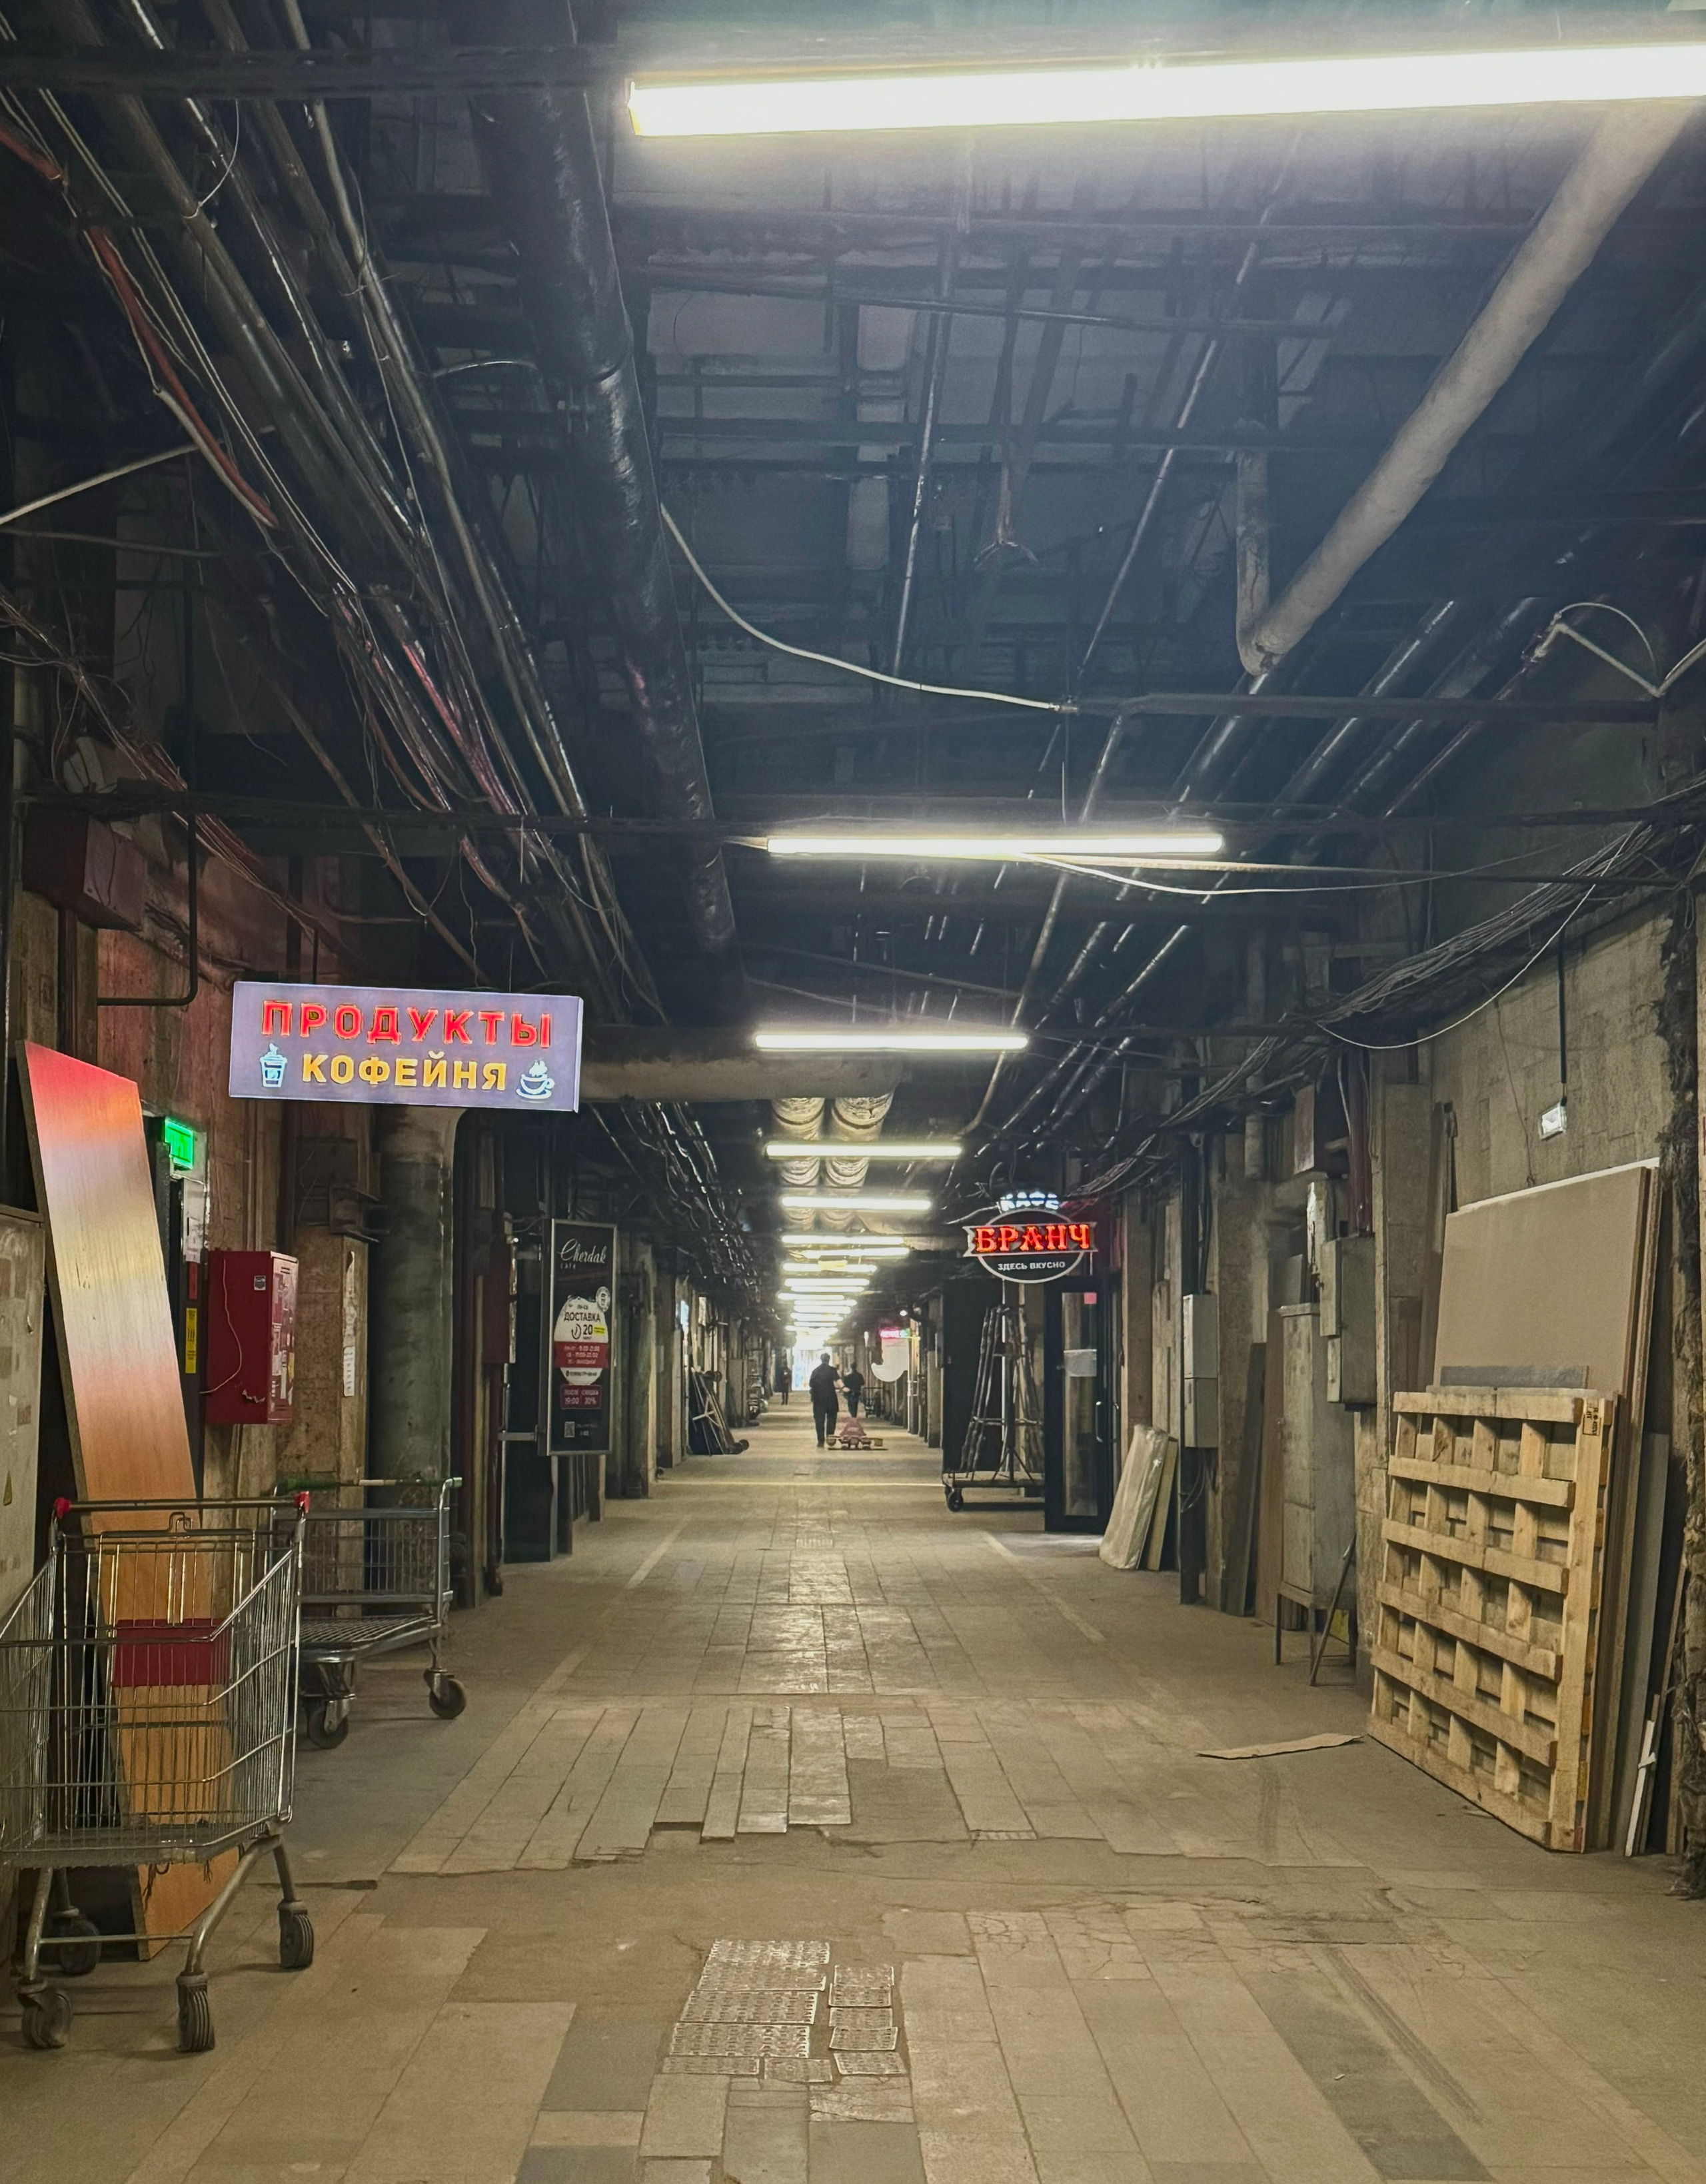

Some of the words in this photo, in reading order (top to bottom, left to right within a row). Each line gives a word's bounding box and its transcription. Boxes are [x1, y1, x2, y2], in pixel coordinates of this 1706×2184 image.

[261, 1000, 551, 1049] ПРОДУКТЫ
[301, 1050, 507, 1091] КОФЕЙНЯ
[557, 1238, 607, 1265] Cherdak
[975, 1224, 1090, 1253] БРАНЧ
[998, 1263, 1028, 1272] ЗДЕСЬ
[1030, 1261, 1066, 1270] ВКУСНО
[563, 1312, 601, 1322] ДОСТАВКА
[582, 1324, 593, 1335] 20
